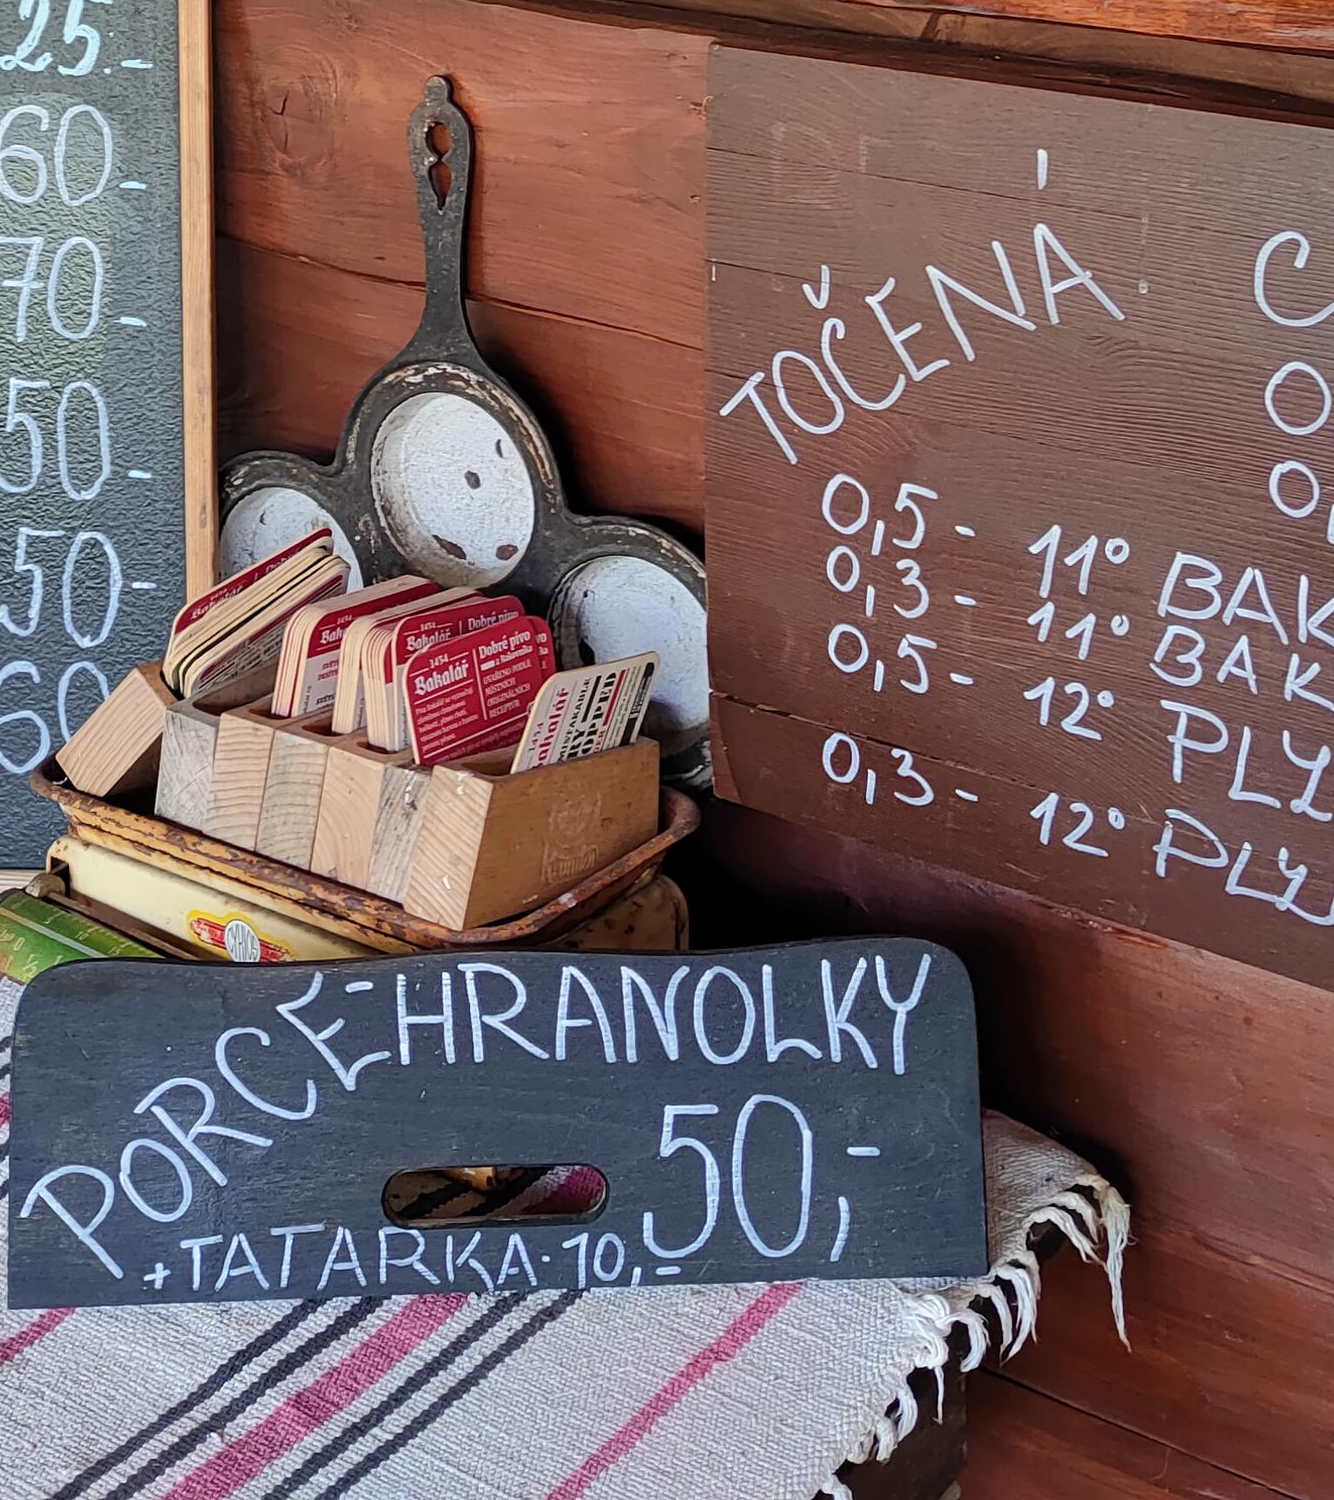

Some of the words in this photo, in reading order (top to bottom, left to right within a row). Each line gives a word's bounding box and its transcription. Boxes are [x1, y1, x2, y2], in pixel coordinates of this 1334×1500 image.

[719, 148, 1125, 466] TOČENÁ
[429, 654, 449, 669] 1454
[478, 634, 508, 659] Dobré
[508, 631, 531, 651] pivo
[414, 660, 469, 696] Bakalář
[533, 687, 569, 766] akalář
[557, 678, 590, 762] MISTAKABLE
[581, 672, 617, 755] OPPED
[567, 729, 587, 759] RY
